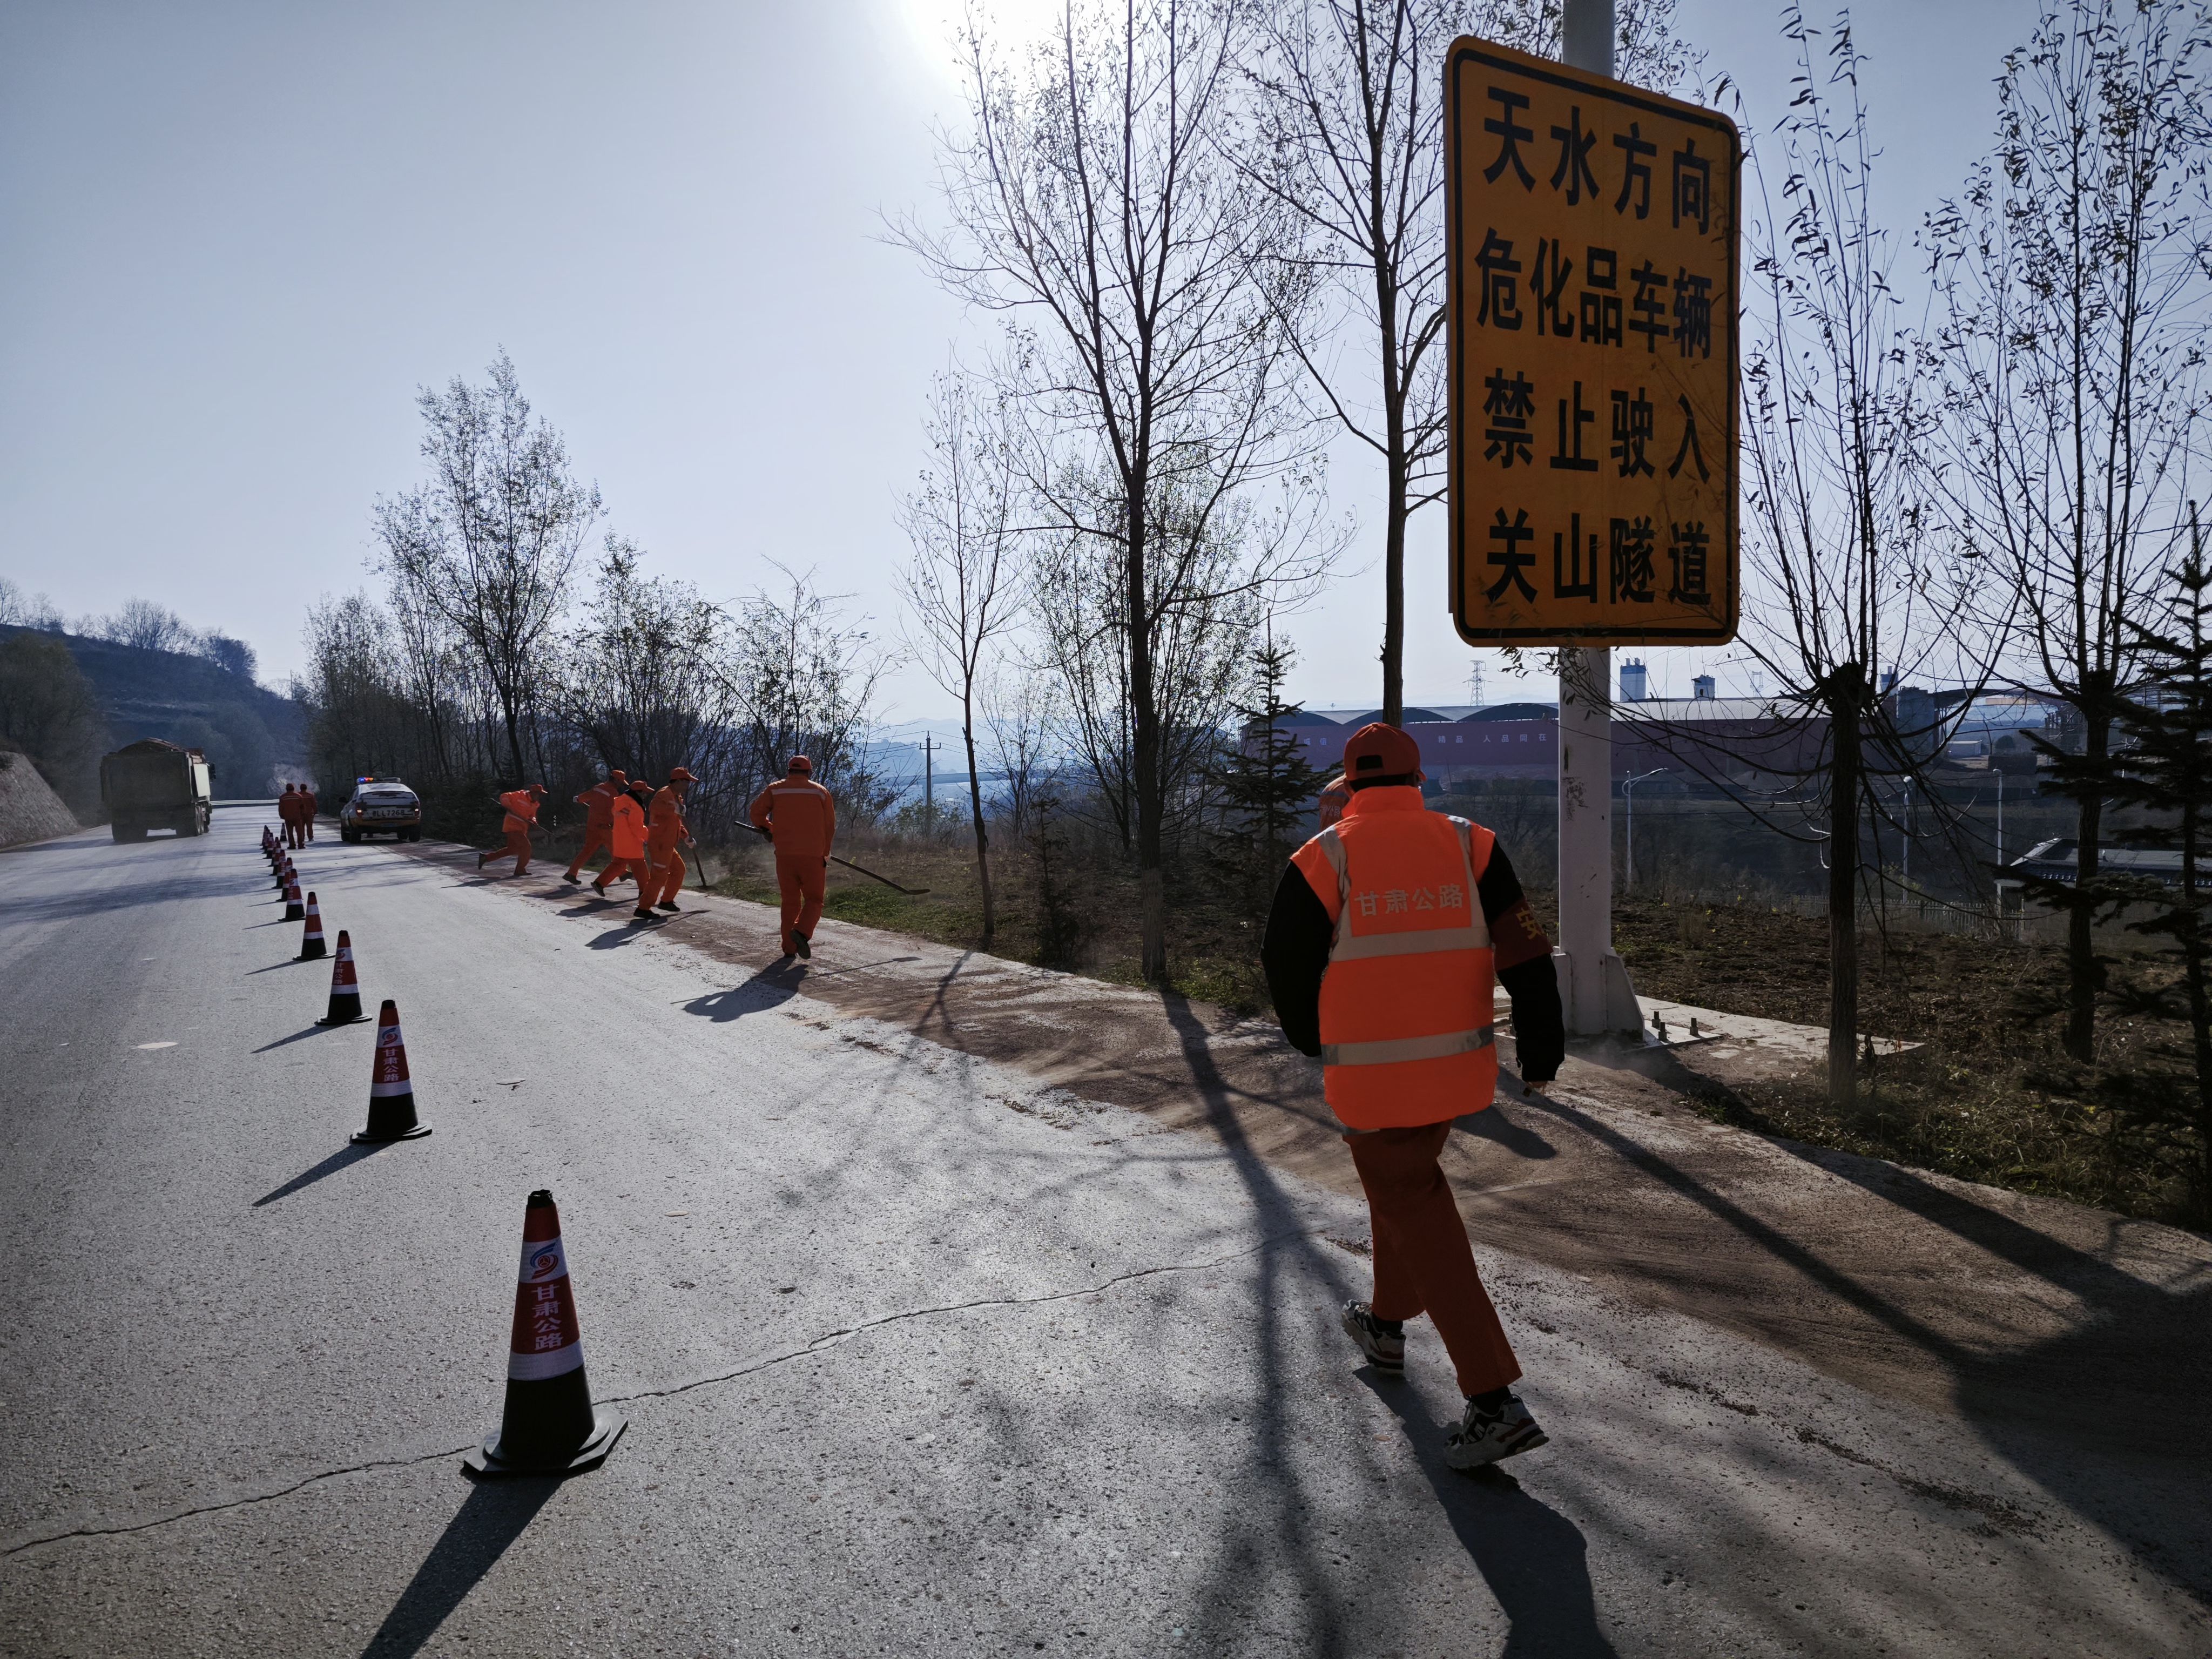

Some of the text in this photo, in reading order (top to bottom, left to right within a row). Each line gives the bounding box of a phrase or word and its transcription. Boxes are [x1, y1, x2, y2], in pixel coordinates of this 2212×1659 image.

[1483, 85, 1709, 235] 天水方向
[1475, 227, 1712, 360] 危化品车辆
[1483, 368, 1710, 485] 禁止驶入
[1486, 507, 1711, 606] 关山隧道
[1483, 733, 1547, 743] 人品同在
[1354, 884, 1464, 917] 甘肃公路
[382, 1048, 400, 1082] 甘肃公路
[531, 1283, 564, 1351] 甘肃公路
